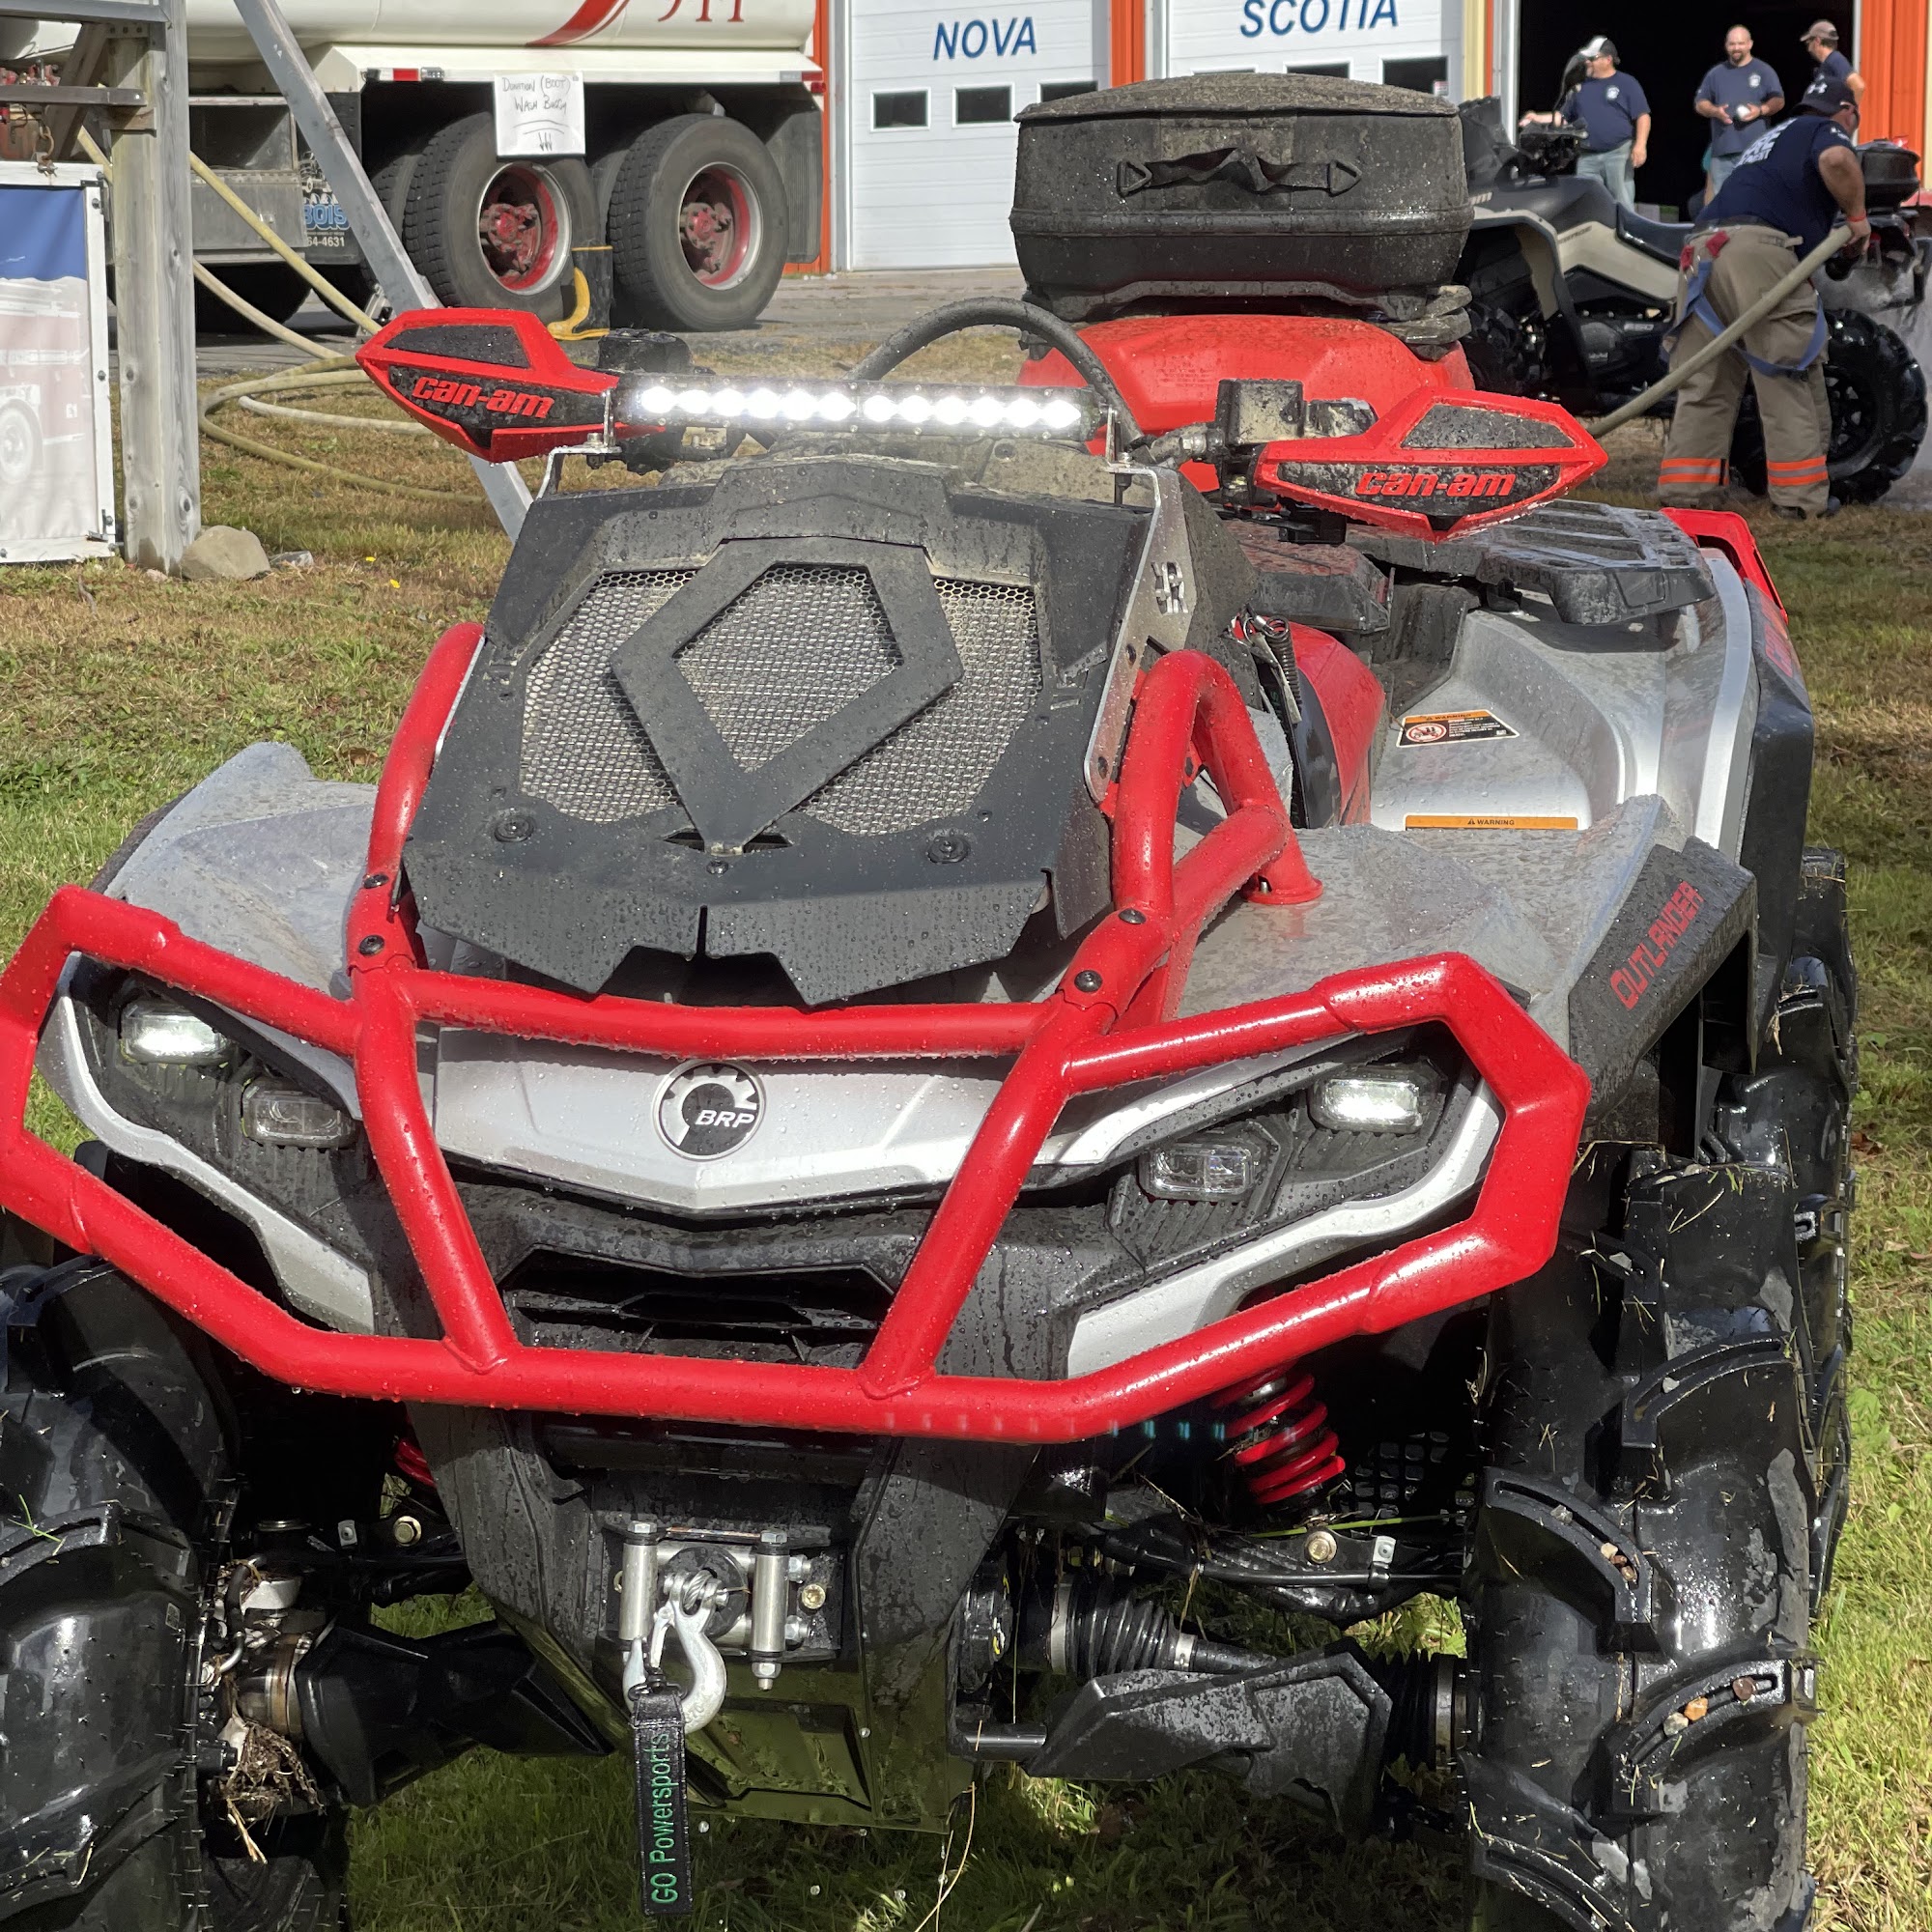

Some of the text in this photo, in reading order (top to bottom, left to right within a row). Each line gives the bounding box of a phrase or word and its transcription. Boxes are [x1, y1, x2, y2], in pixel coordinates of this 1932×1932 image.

[933, 0, 1399, 61] NOVA SCOTIA
[514, 96, 538, 112] WASH
[412, 376, 554, 419] can-am
[1355, 472, 1516, 497] can-am
[1609, 880, 1706, 1009] OUTLANDER
[696, 1109, 755, 1128] BRP
[643, 1732, 680, 1905] GO Powersports
